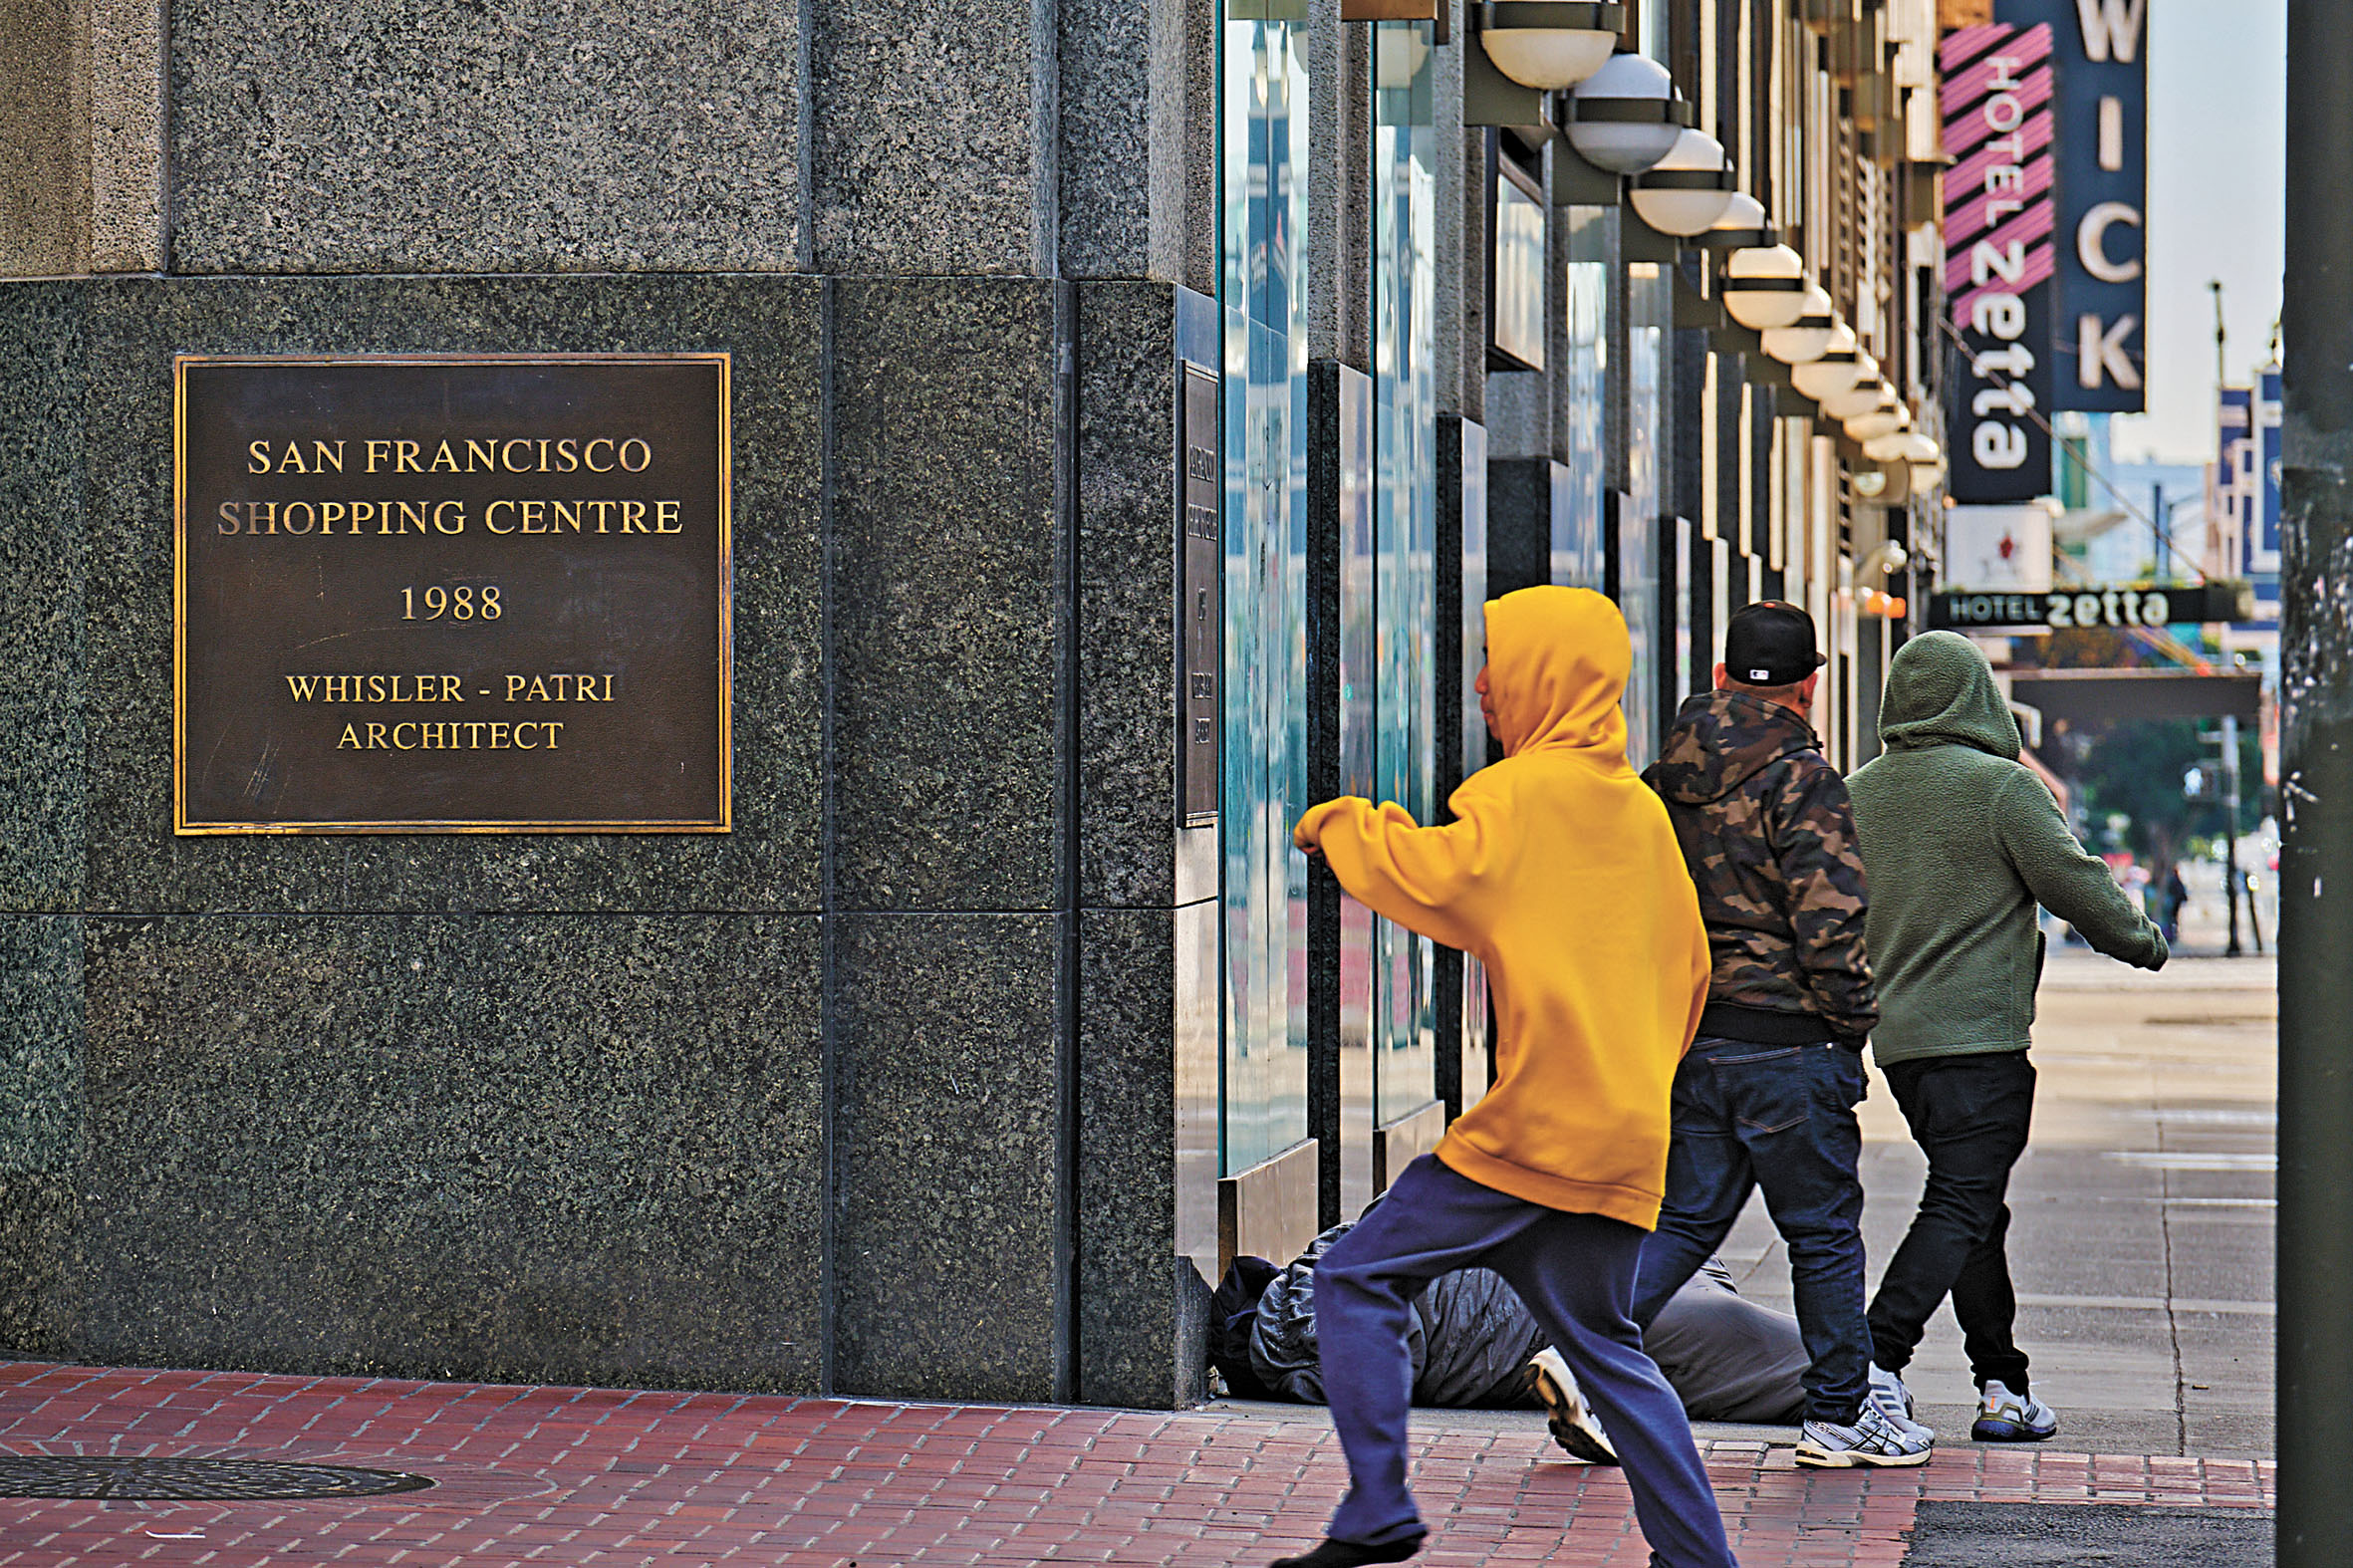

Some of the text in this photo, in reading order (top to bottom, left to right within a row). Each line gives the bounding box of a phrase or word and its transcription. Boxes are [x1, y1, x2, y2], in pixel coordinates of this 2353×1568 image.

[2077, 0, 2143, 390] WICK
[1971, 56, 2035, 470] HOTEL zetta
[247, 437, 653, 474] SAN FRANCISCO
[217, 499, 684, 536] SHOPPING CENTRE
[400, 586, 502, 622] 1988
[1949, 591, 2170, 628] HOTEL zetta
[286, 674, 464, 703] WHISLER
[505, 673, 615, 702] PATRI
[337, 721, 564, 751] ARCHITECT
